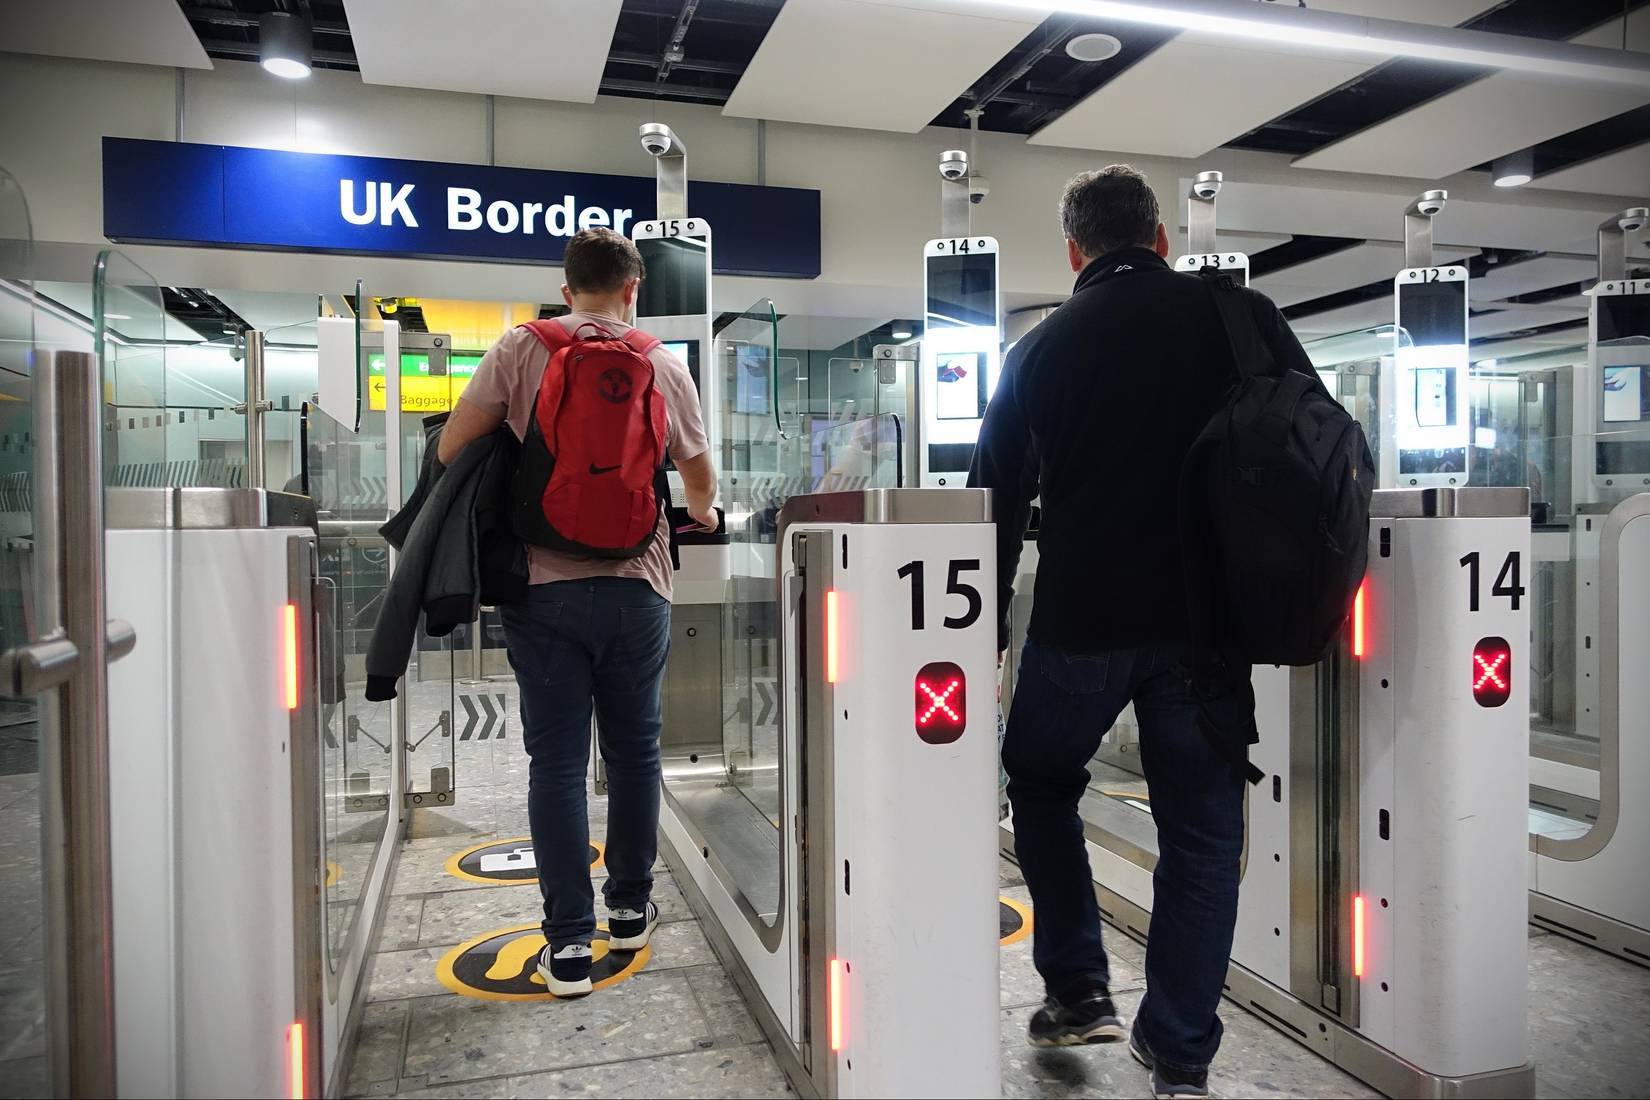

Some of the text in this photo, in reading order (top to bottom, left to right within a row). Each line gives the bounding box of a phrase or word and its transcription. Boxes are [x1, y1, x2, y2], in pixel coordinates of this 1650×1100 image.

[340, 179, 632, 237] UK Border
[659, 220, 680, 237] 15
[950, 239, 970, 255] 14
[1422, 269, 1440, 284] 12
[1620, 282, 1636, 294] 11
[1459, 552, 1525, 611] 14
[897, 559, 982, 630] 15
